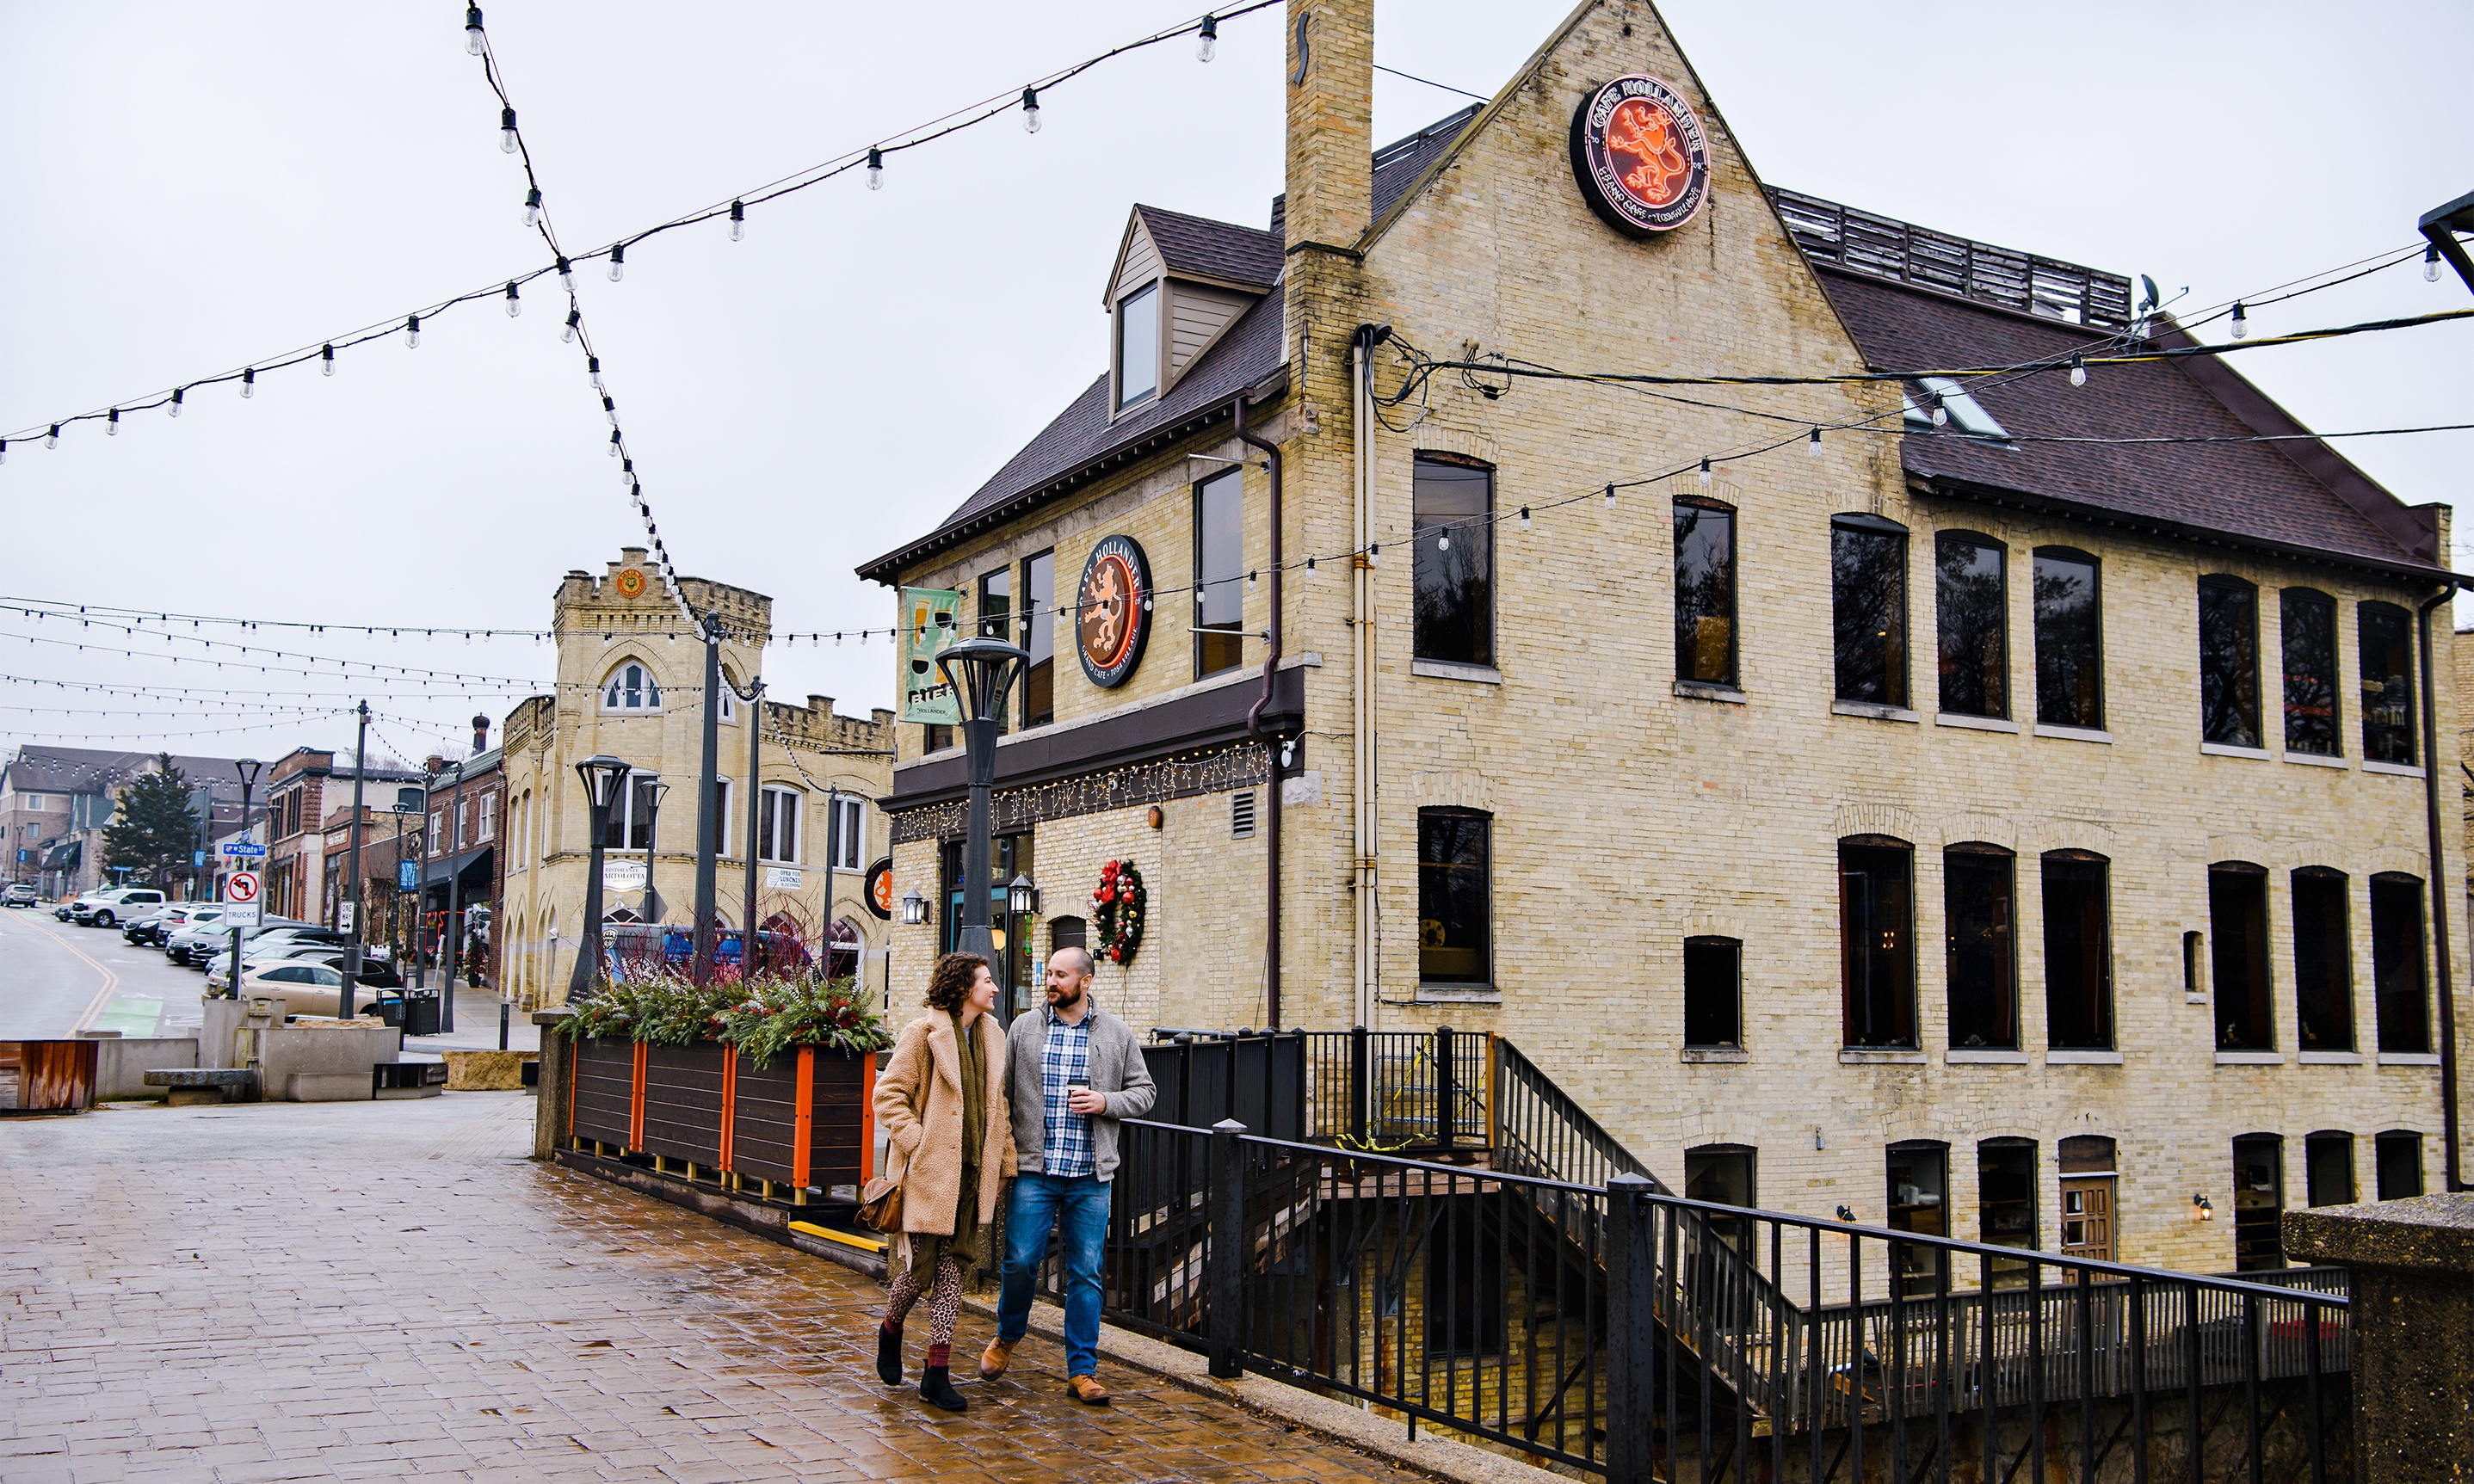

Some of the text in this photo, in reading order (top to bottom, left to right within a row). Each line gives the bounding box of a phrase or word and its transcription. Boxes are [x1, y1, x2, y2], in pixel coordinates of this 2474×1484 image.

[1592, 79, 1703, 152] CAFE HOLLANDER
[1599, 166, 1625, 202] GRAND
[1095, 541, 1140, 590] HOLLANDER
[1082, 626, 1138, 680] GRAND CAFE TOSA VILLAGE
[916, 707, 948, 716] HOLLANDER
